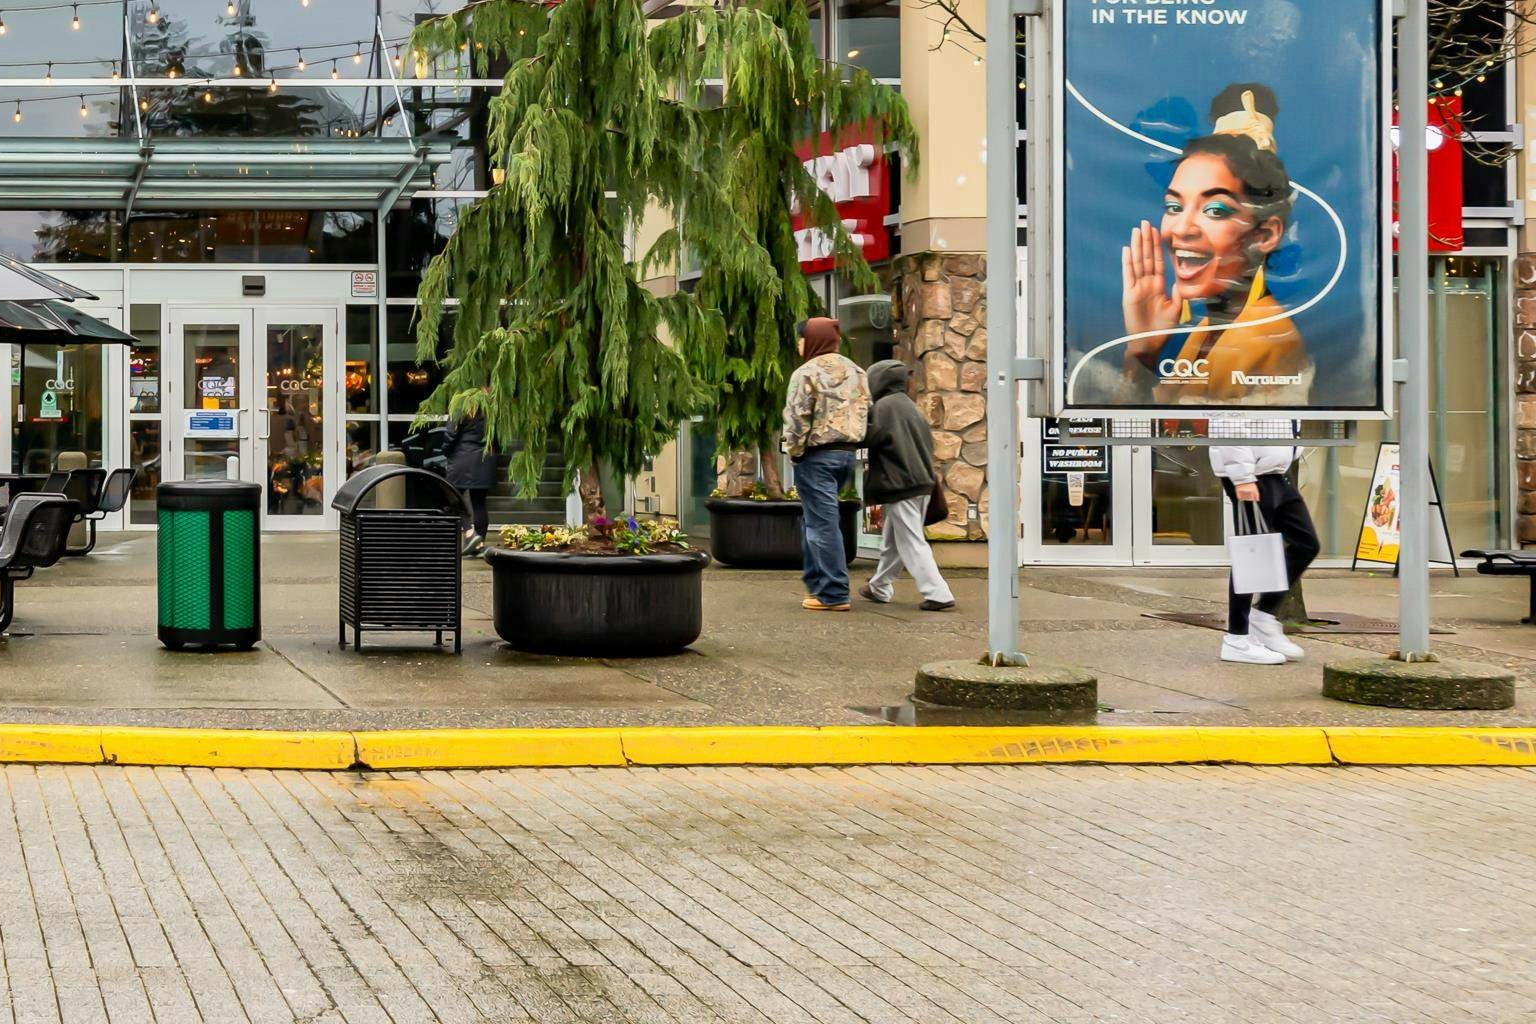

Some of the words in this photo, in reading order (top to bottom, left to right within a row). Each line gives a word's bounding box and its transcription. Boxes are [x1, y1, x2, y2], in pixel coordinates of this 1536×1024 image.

[1092, 9, 1114, 24] IN
[1122, 9, 1168, 24] THE
[1176, 9, 1248, 25] KNOW
[1158, 358, 1210, 377] CQC
[46, 379, 74, 391] CQC
[280, 379, 310, 391] CQC
[1065, 449, 1099, 457] PUBLIC
[1049, 460, 1103, 468] WASHROOM
